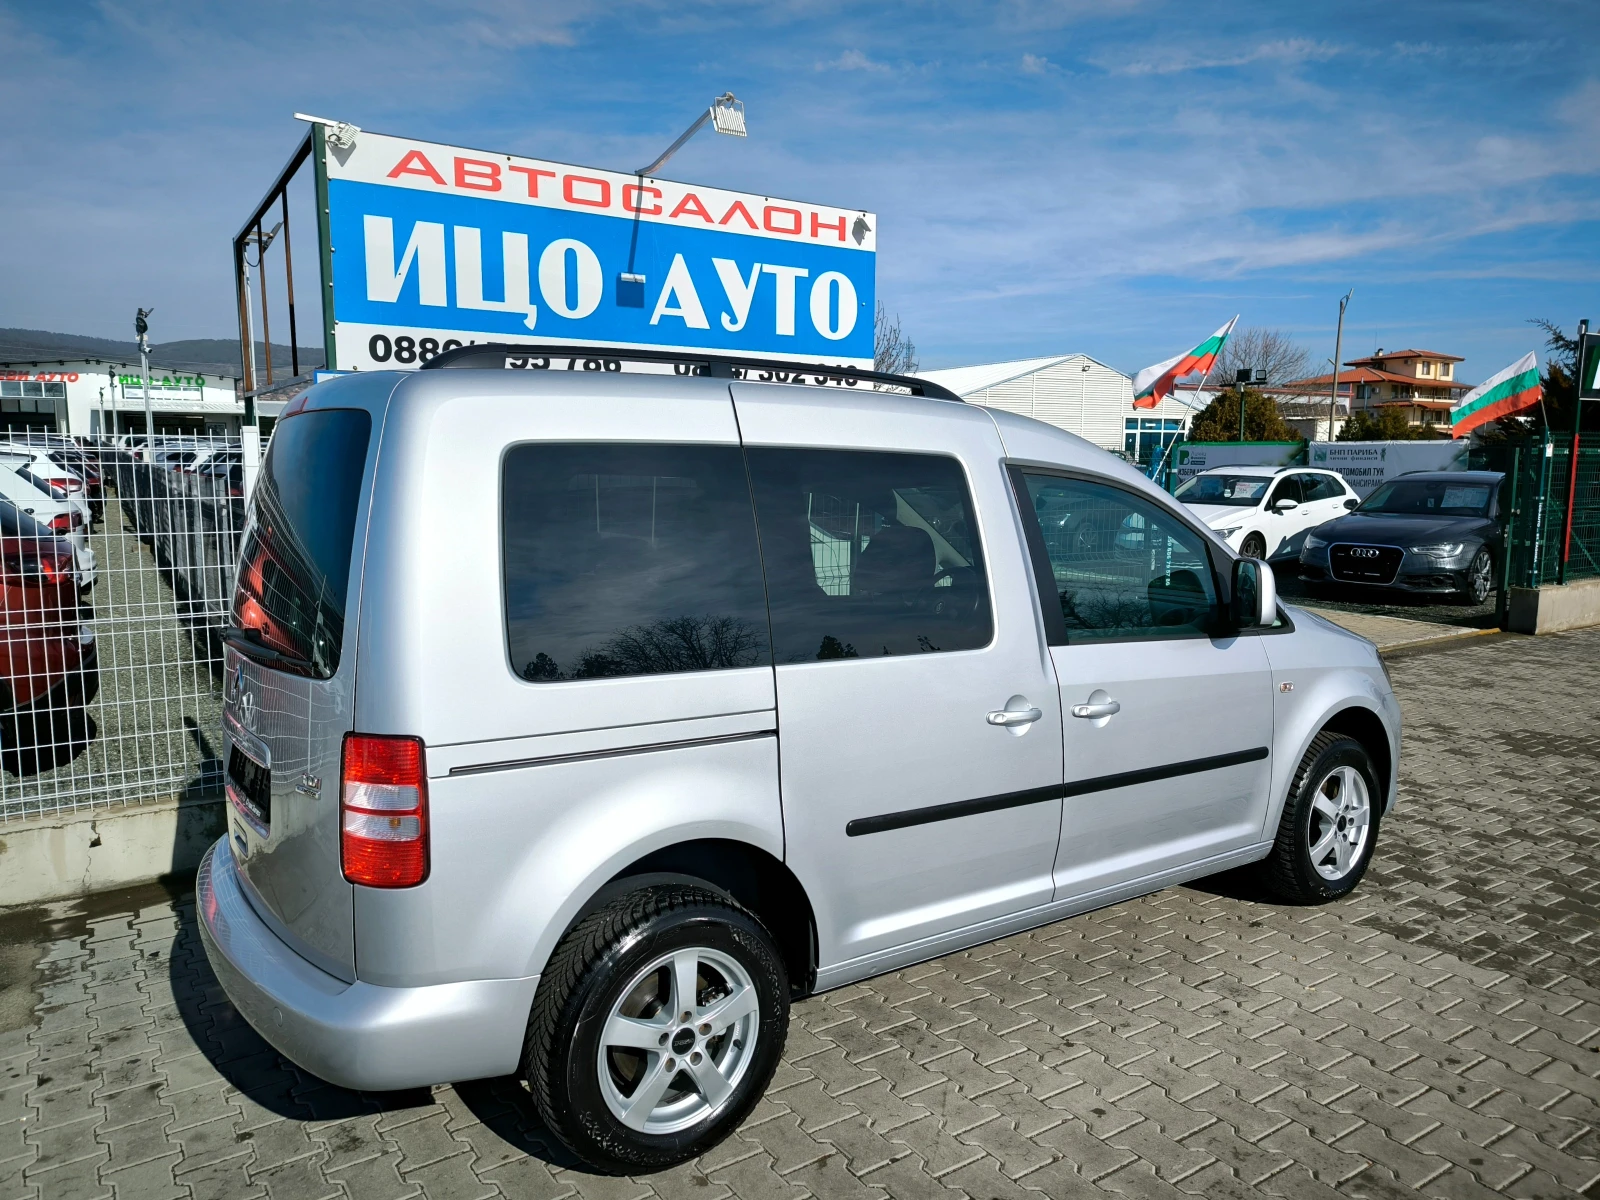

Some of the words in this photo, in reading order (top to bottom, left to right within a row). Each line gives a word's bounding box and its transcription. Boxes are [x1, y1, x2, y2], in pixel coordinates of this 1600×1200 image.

[387, 149, 848, 242] АВТОСАЛОН
[363, 214, 604, 331] ИЦО
[649, 253, 858, 341] АУТО
[35, 371, 80, 382] АУТО
[1372, 467, 1385, 477] ТУК
